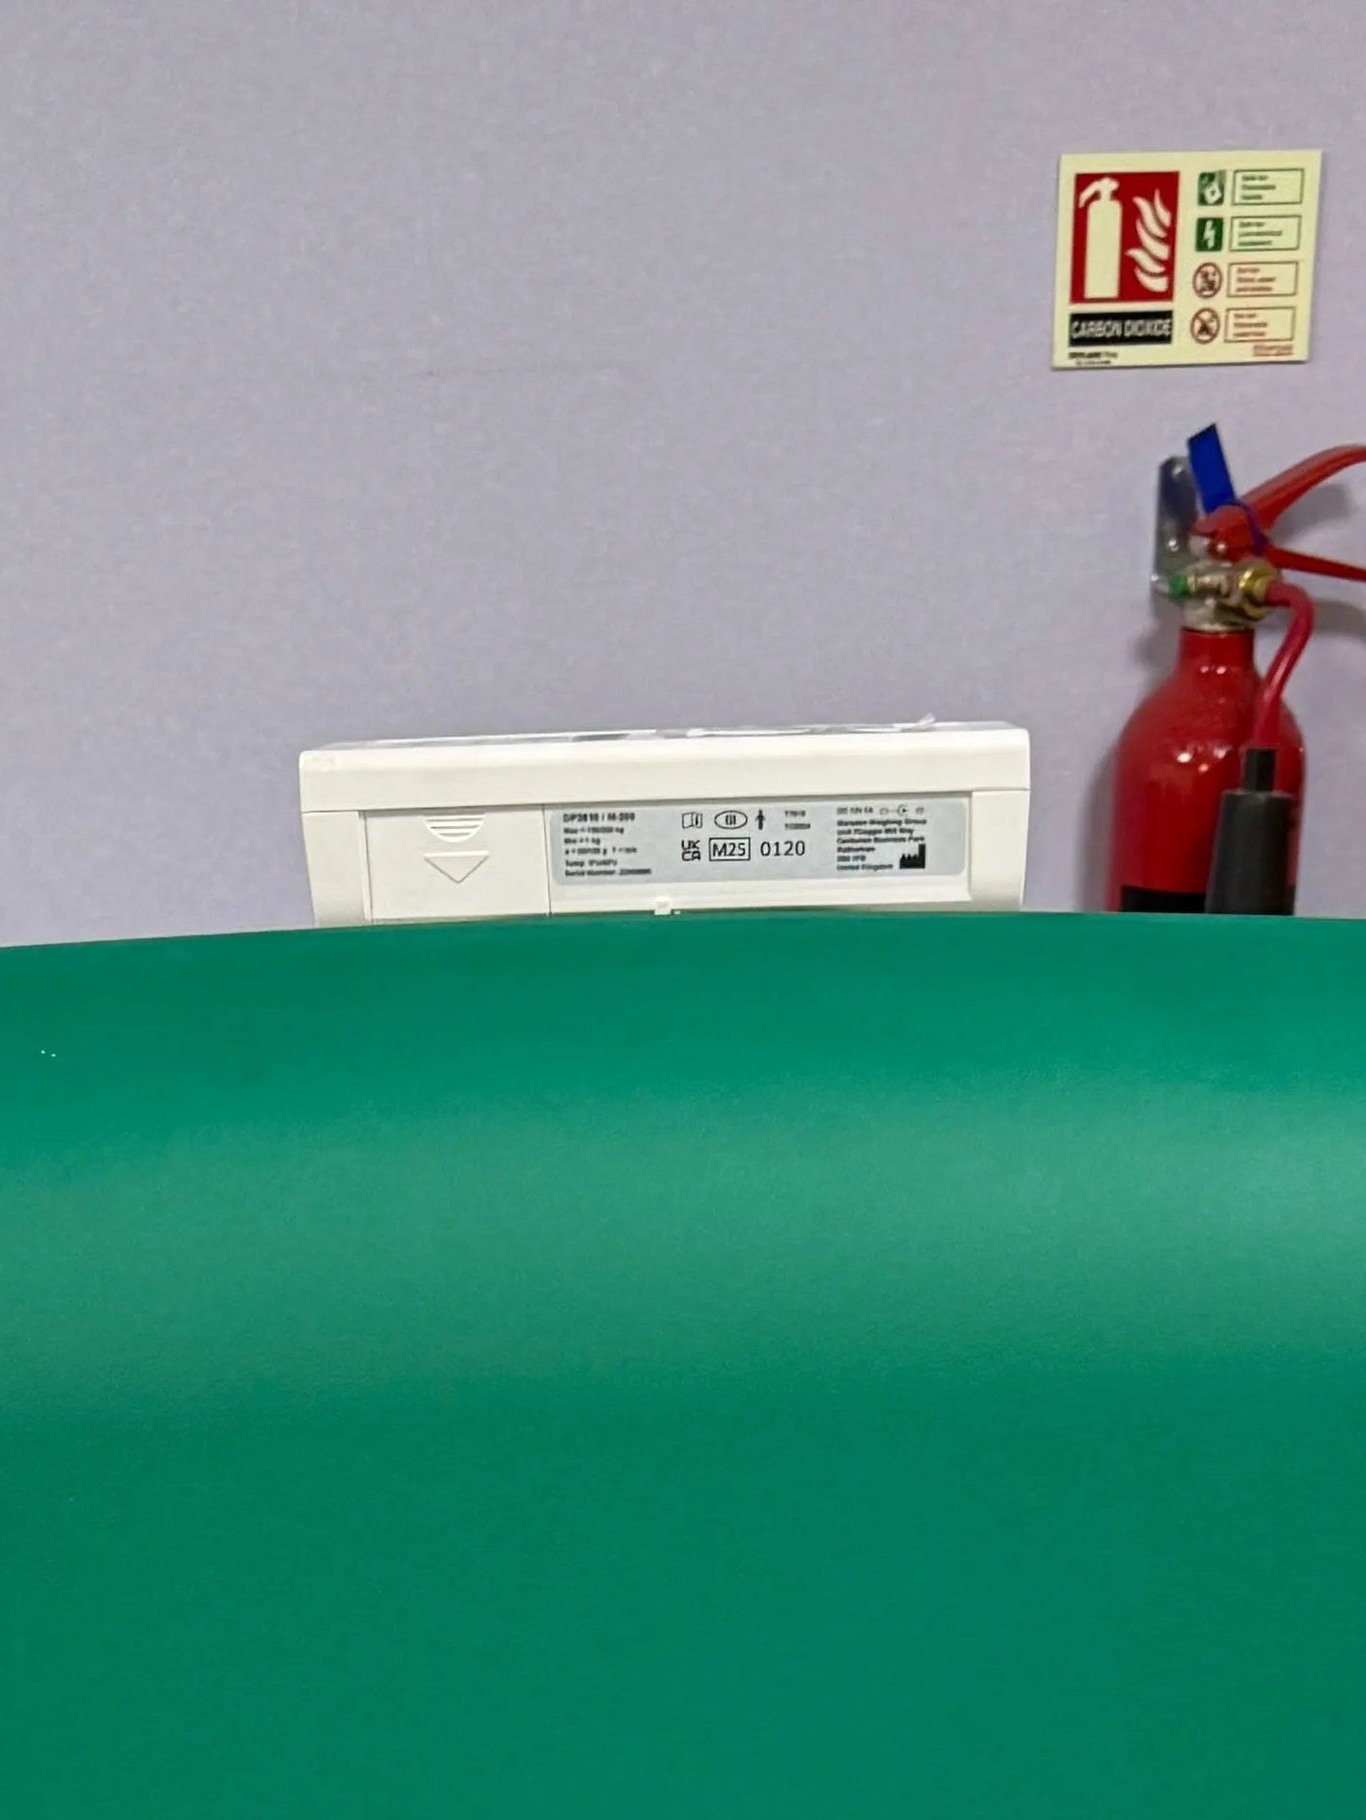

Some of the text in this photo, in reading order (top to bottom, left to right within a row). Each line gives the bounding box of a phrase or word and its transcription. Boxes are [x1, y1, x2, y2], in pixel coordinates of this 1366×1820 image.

[1071, 318, 1172, 339] CARBON DIOXIDE
[712, 842, 746, 857] M25
[760, 840, 806, 857] 0120
